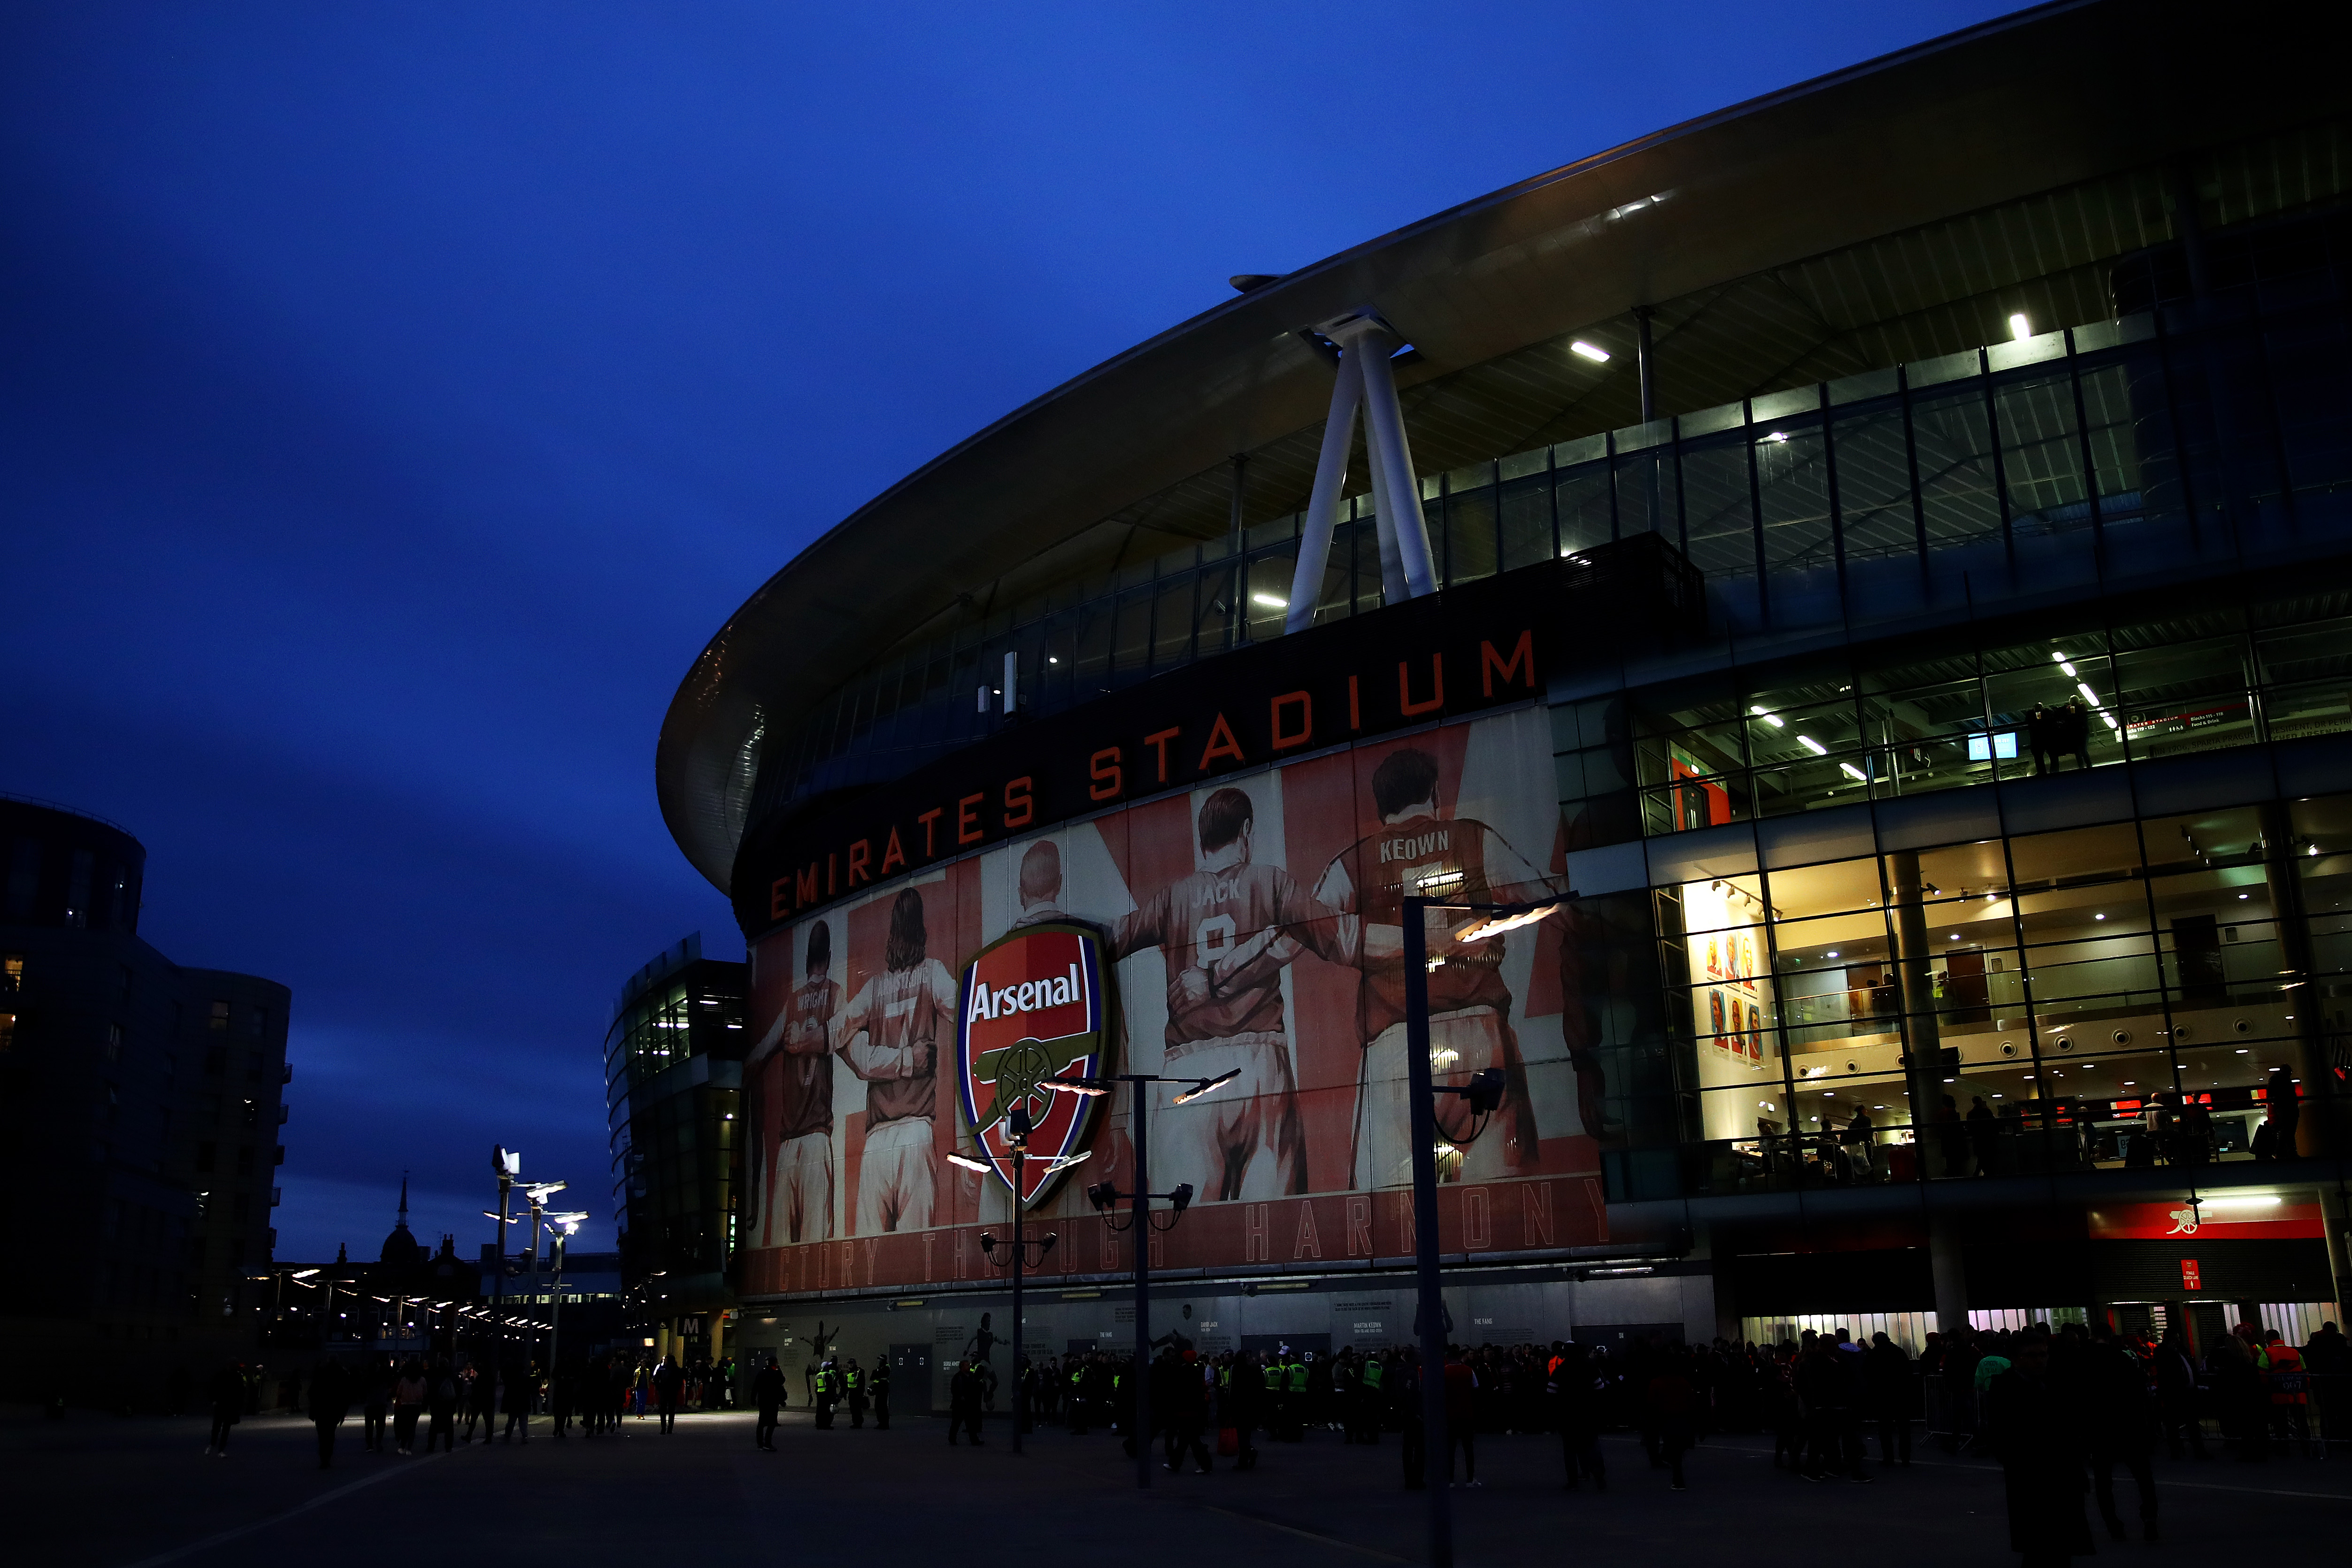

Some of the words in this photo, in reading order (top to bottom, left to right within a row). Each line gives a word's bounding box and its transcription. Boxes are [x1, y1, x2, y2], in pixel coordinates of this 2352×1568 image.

[2270, 723, 2312, 734] RESIDENT,
[771, 776, 1035, 921] EMIRATES
[1089, 629, 1536, 801] STADIUM
[1380, 830, 1449, 864] KEOWN
[1192, 878, 1240, 909] JACK
[798, 988, 829, 1011] WRIGHT
[970, 963, 1081, 1023] Arsenal
[683, 1318, 699, 1334] M
